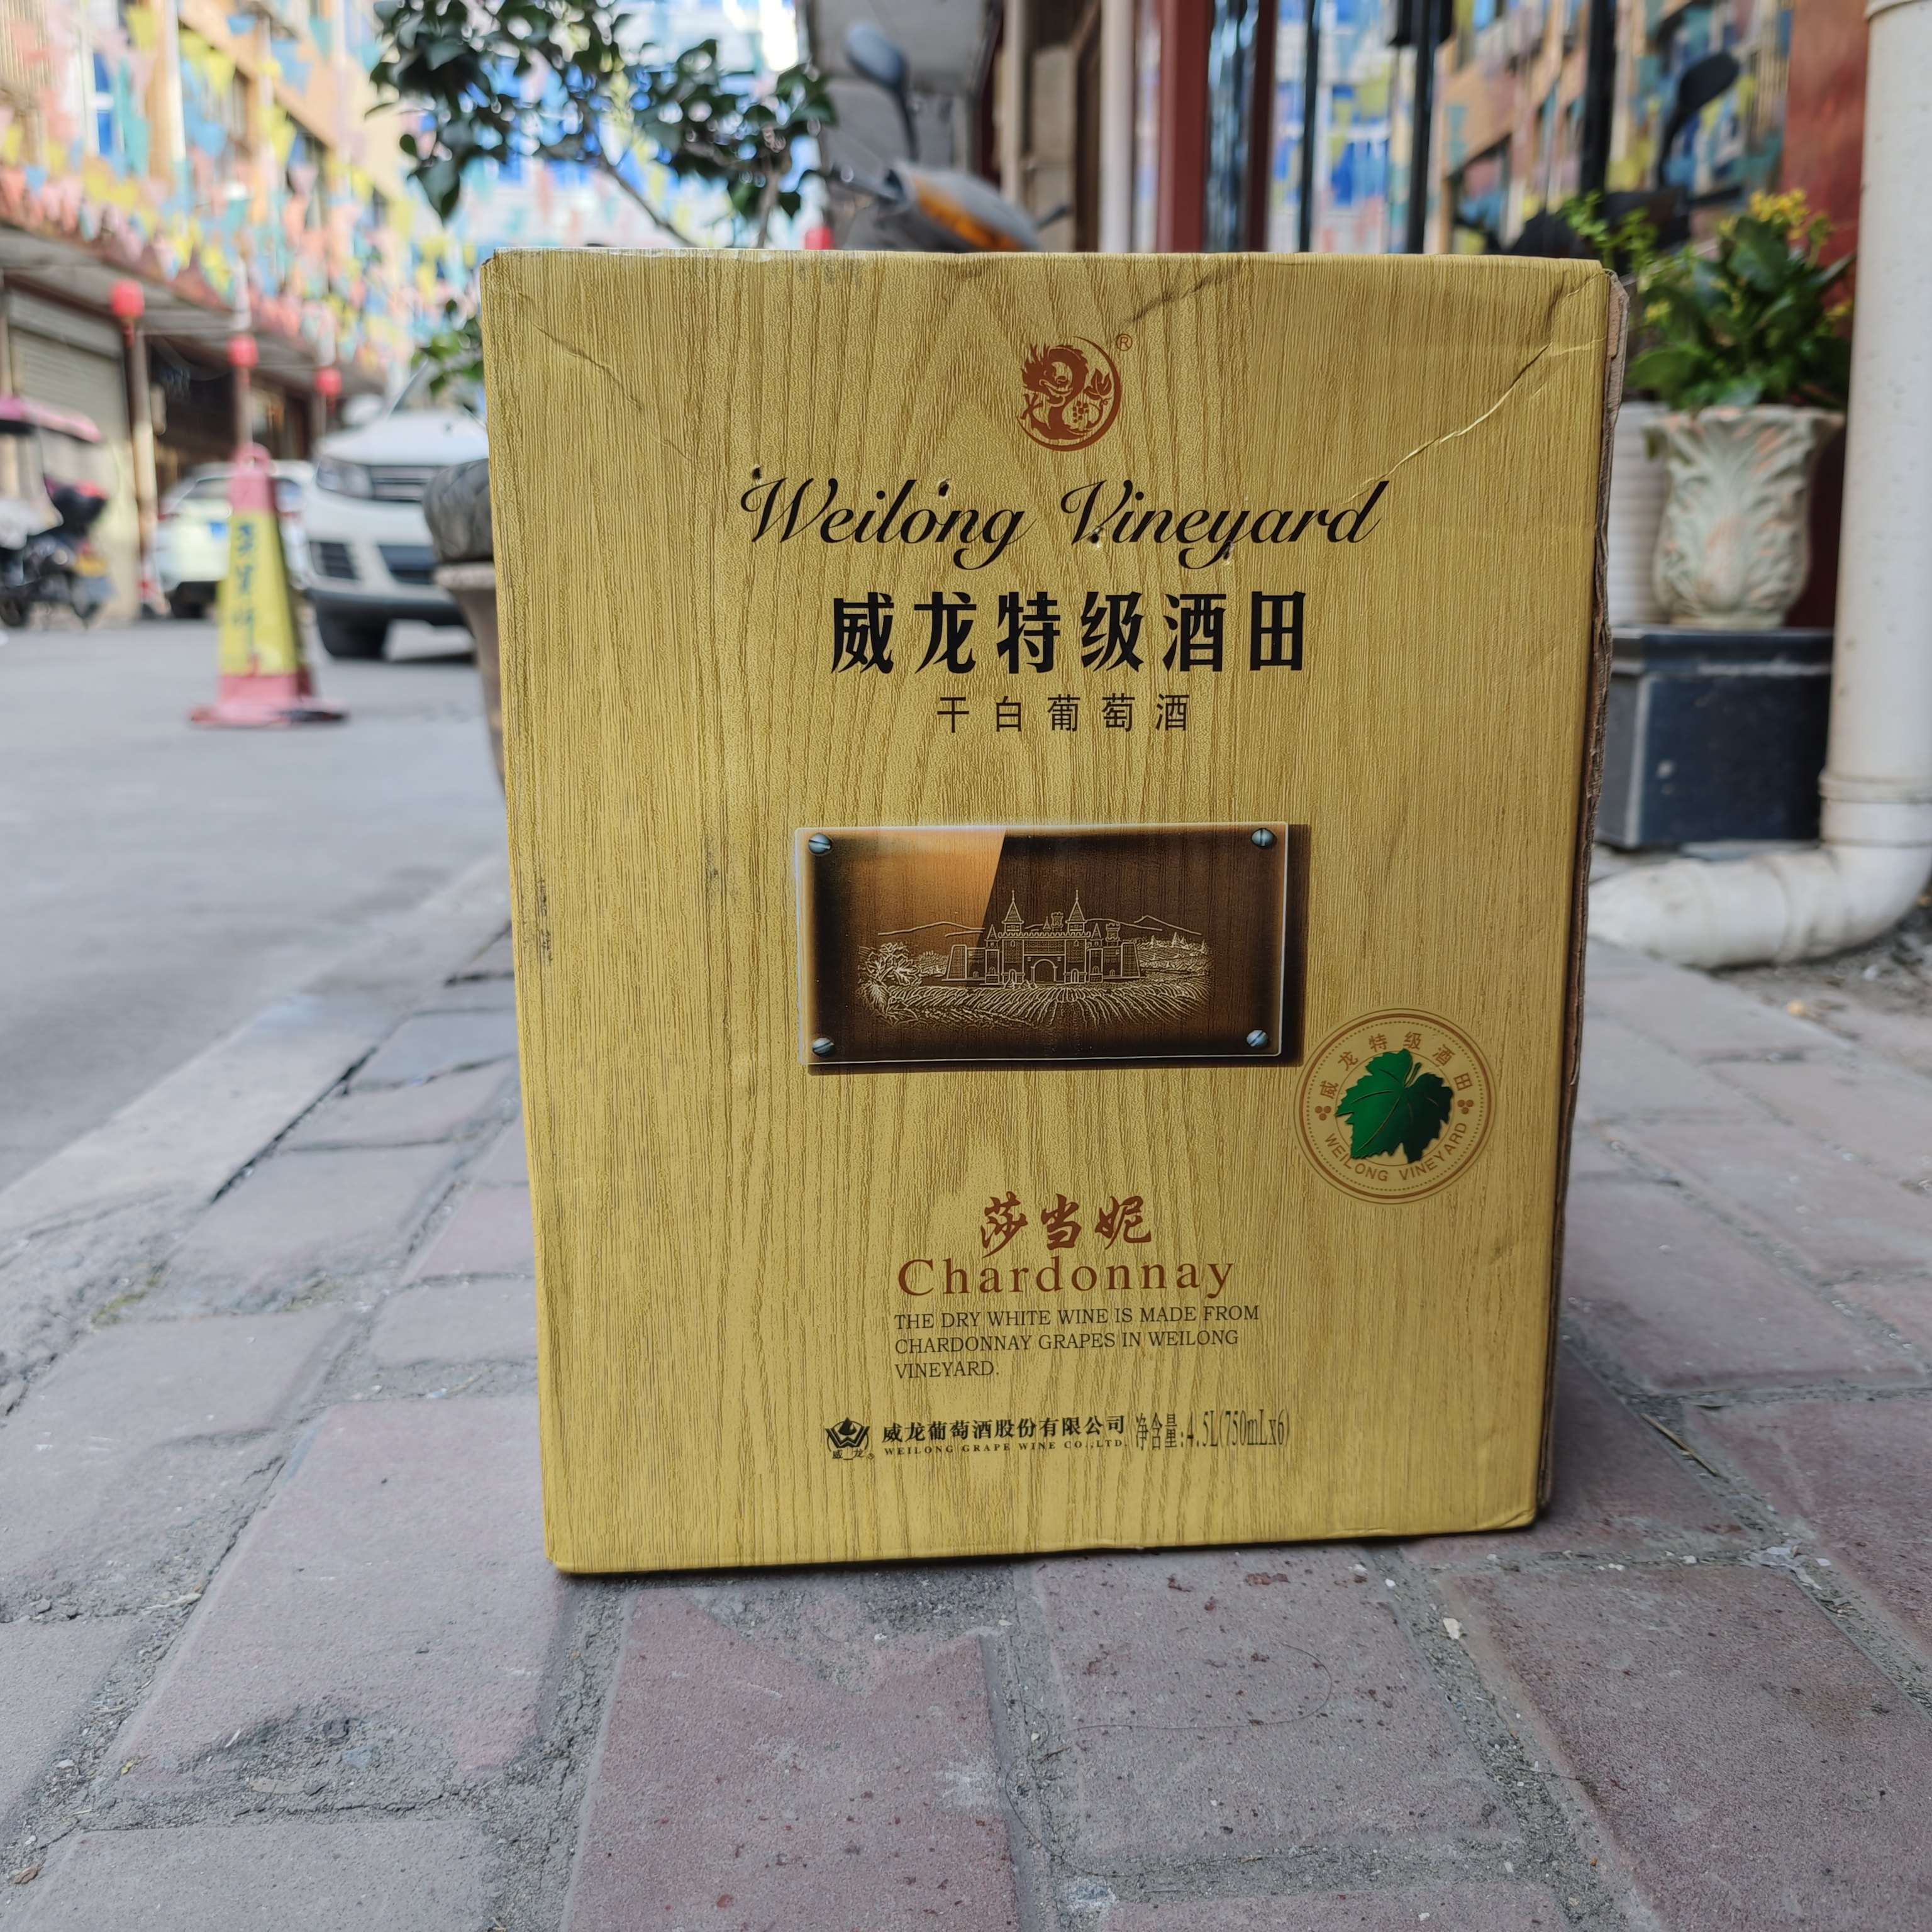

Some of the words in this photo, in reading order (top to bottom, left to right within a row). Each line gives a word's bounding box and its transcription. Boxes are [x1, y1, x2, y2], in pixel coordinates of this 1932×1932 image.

[740, 477, 1036, 570] Weilong
[1061, 479, 1390, 570] Vineyard
[831, 590, 1307, 674] 威龙特级酒田
[936, 692, 1191, 733] 干白葡萄酒
[1319, 1031, 1473, 1101] 威龙特级酒田
[1324, 1133, 1389, 1182] WEILONG
[1398, 1122, 1467, 1181] VINEYARD
[980, 1191, 1152, 1258] 莎当妮
[897, 1255, 1235, 1299] Chardonnay
[894, 1313, 935, 1330] THE
[941, 1311, 982, 1328] DRY
[987, 1310, 1052, 1327] WHITE
[1057, 1309, 1109, 1325] WINE
[1114, 1307, 1133, 1324] IS
[1140, 1306, 1197, 1323] MADE
[1203, 1304, 1260, 1321] FROM
[894, 1335, 1033, 1354] CHARDONNAY
[1038, 1332, 1116, 1350] GRAPES
[1121, 1331, 1142, 1347] IN
[1147, 1330, 1240, 1346] WEILONG
[894, 1360, 1000, 1379] VINEYARD.
[881, 1414, 1126, 1443] 威龙葡萄酒股份有限公司
[884, 1445, 954, 1456] WEILONG
[962, 1443, 1011, 1453] GRAPE
[1019, 1441, 1057, 1451] WINE
